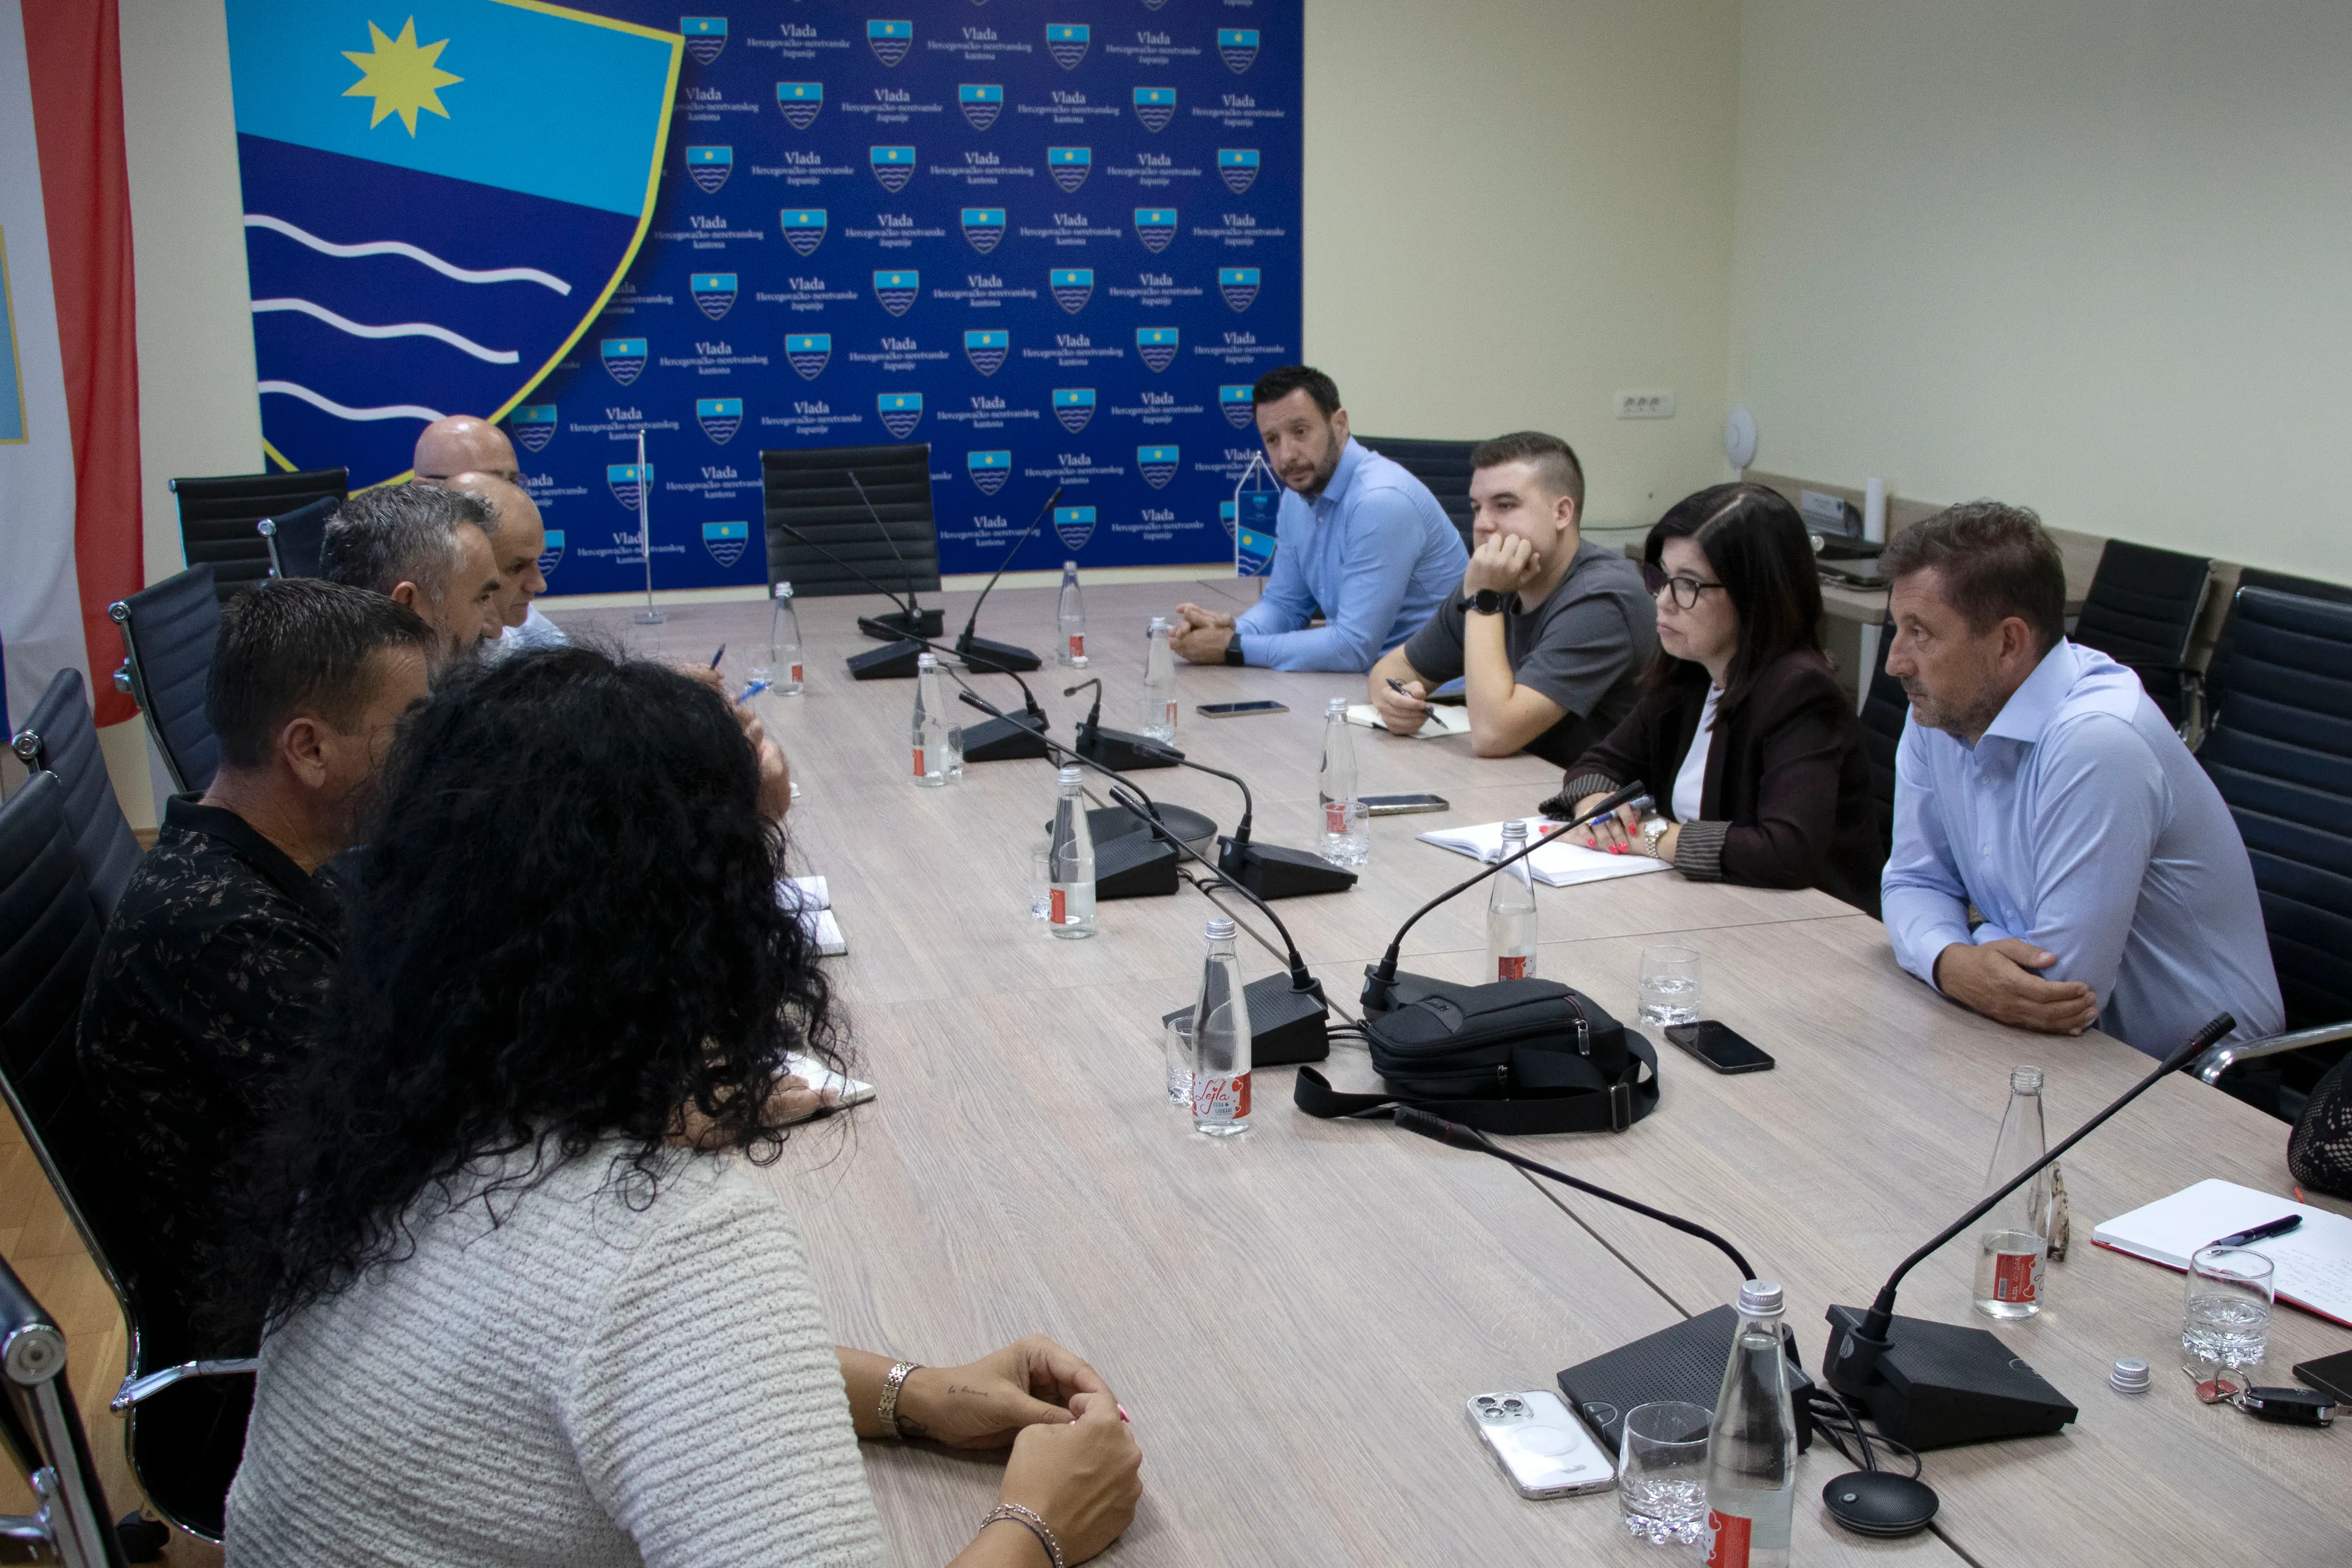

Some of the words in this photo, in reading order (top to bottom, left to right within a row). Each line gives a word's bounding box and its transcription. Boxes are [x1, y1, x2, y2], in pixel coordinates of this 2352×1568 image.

[781, 24, 816, 37] Vlada
[962, 28, 997, 40] Vlada
[1137, 32, 1170, 45] Vlada
[686, 88, 722, 100] Vlada
[875, 89, 910, 102] Vlada
[1052, 92, 1086, 104] Vlada
[1222, 96, 1254, 107] Vlada
[785, 152, 820, 165] Vlada
[965, 153, 999, 165] Vlada
[1137, 154, 1171, 166] Vlada
[691, 216, 726, 229] Vlada
[878, 214, 913, 227] Vlada
[1054, 214, 1087, 226] Vlada
[1223, 214, 1254, 226] Vlada
[788, 278, 825, 290] Vlada
[968, 275, 1003, 288] Vlada
[1140, 274, 1172, 286] Vlada
[881, 337, 916, 350] Vlada
[1056, 335, 1090, 347] Vlada
[1223, 333, 1255, 344] Vlada
[695, 342, 732, 355] Vlada
[971, 396, 1005, 409] Vlada
[1141, 393, 1174, 404] Vlada
[606, 407, 642, 420] Vlada
[793, 402, 829, 414] Vlada
[1058, 454, 1091, 466] Vlada
[701, 467, 737, 479] Vlada
[1141, 510, 1174, 521] Vlada
[973, 516, 1007, 529] Vlada
[612, 532, 644, 544] Vlad
[1196, 1080, 1230, 1114] Lejla
